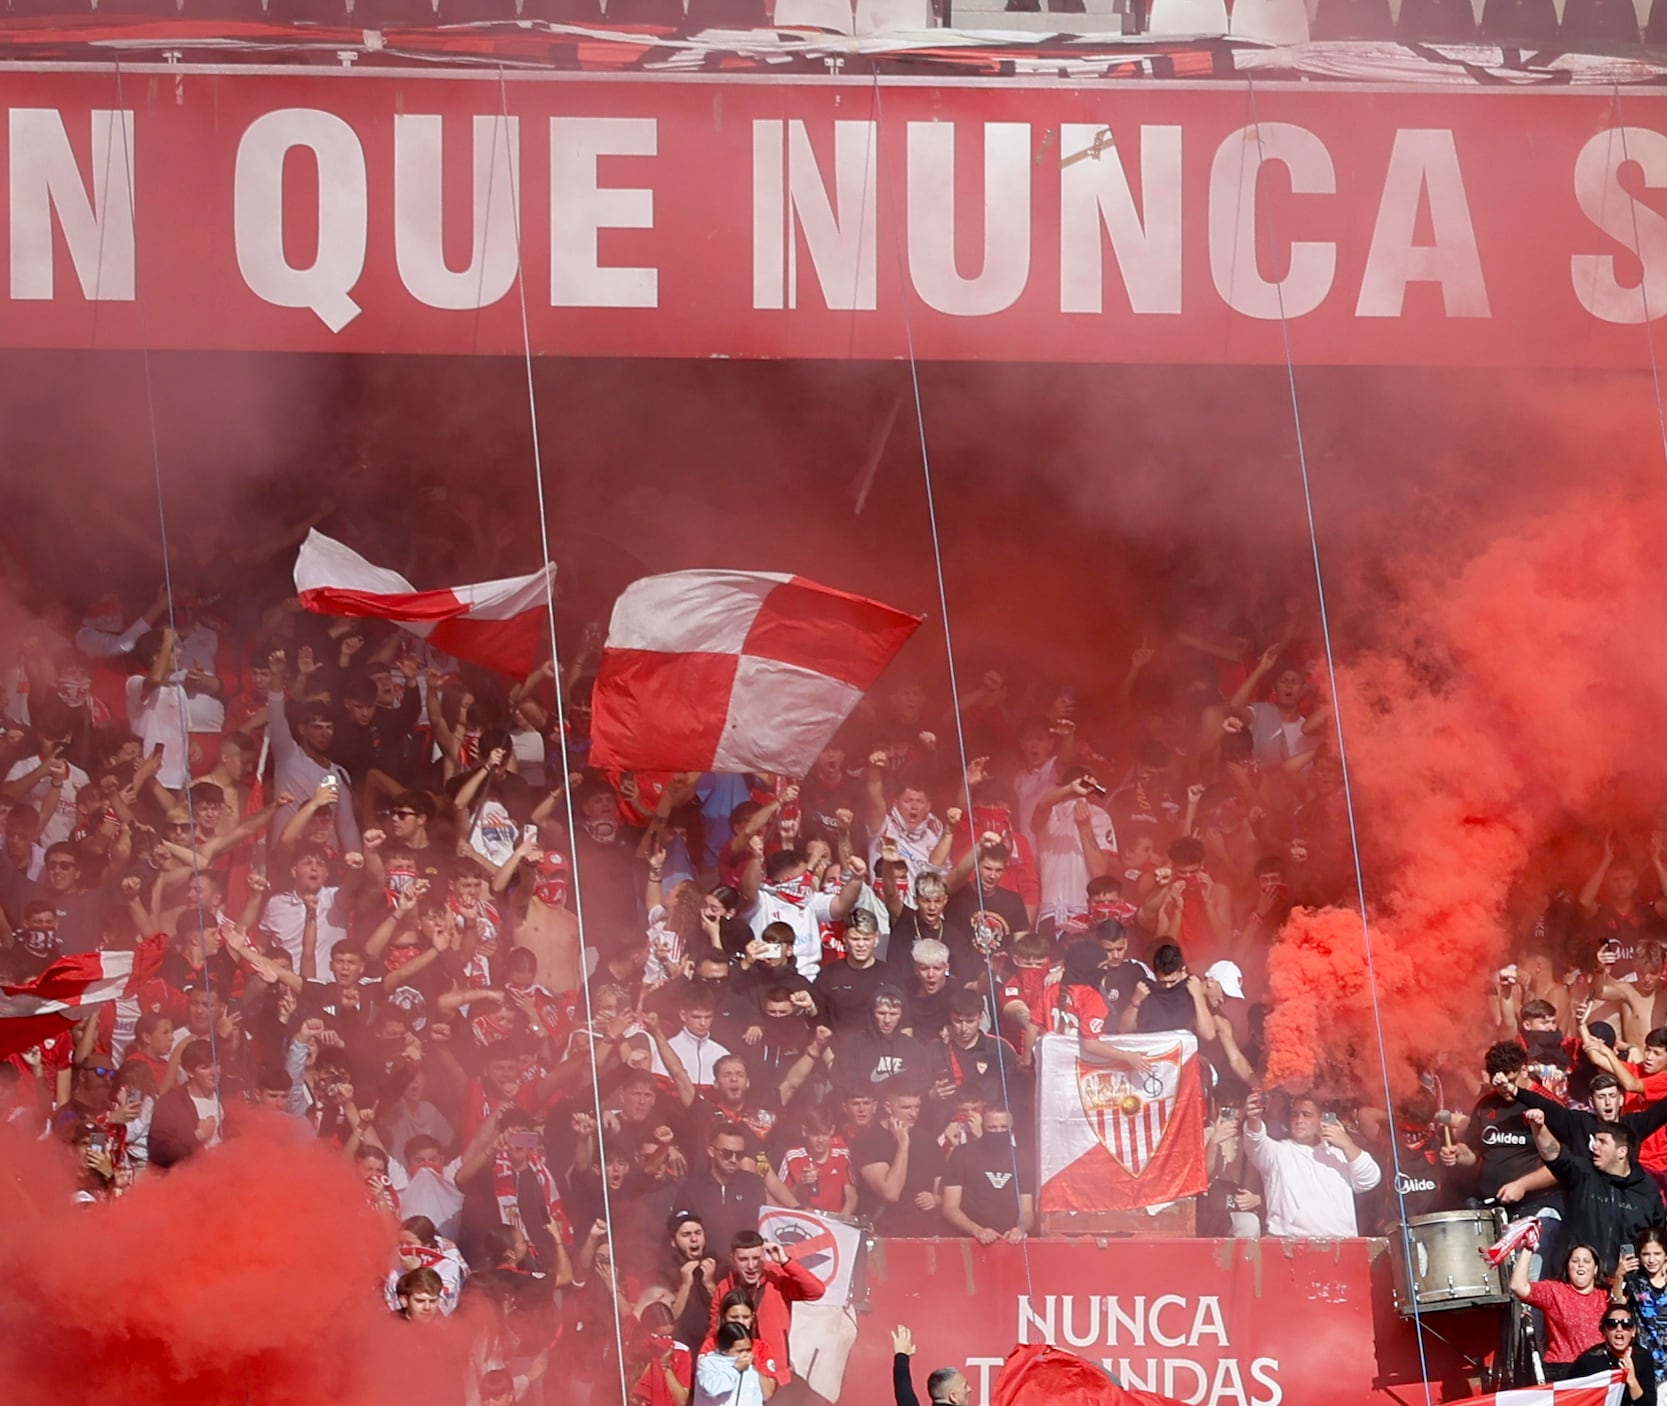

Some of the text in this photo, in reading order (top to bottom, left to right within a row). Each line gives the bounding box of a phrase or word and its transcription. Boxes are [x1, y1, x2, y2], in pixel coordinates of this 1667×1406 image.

[9, 108, 136, 302] N
[234, 108, 659, 334] QUE
[752, 119, 1492, 321] NUNCA
[1482, 1126, 1526, 1146] Midea
[1395, 1172, 1437, 1195] Mide
[1016, 1294, 1231, 1347] NUNCA
